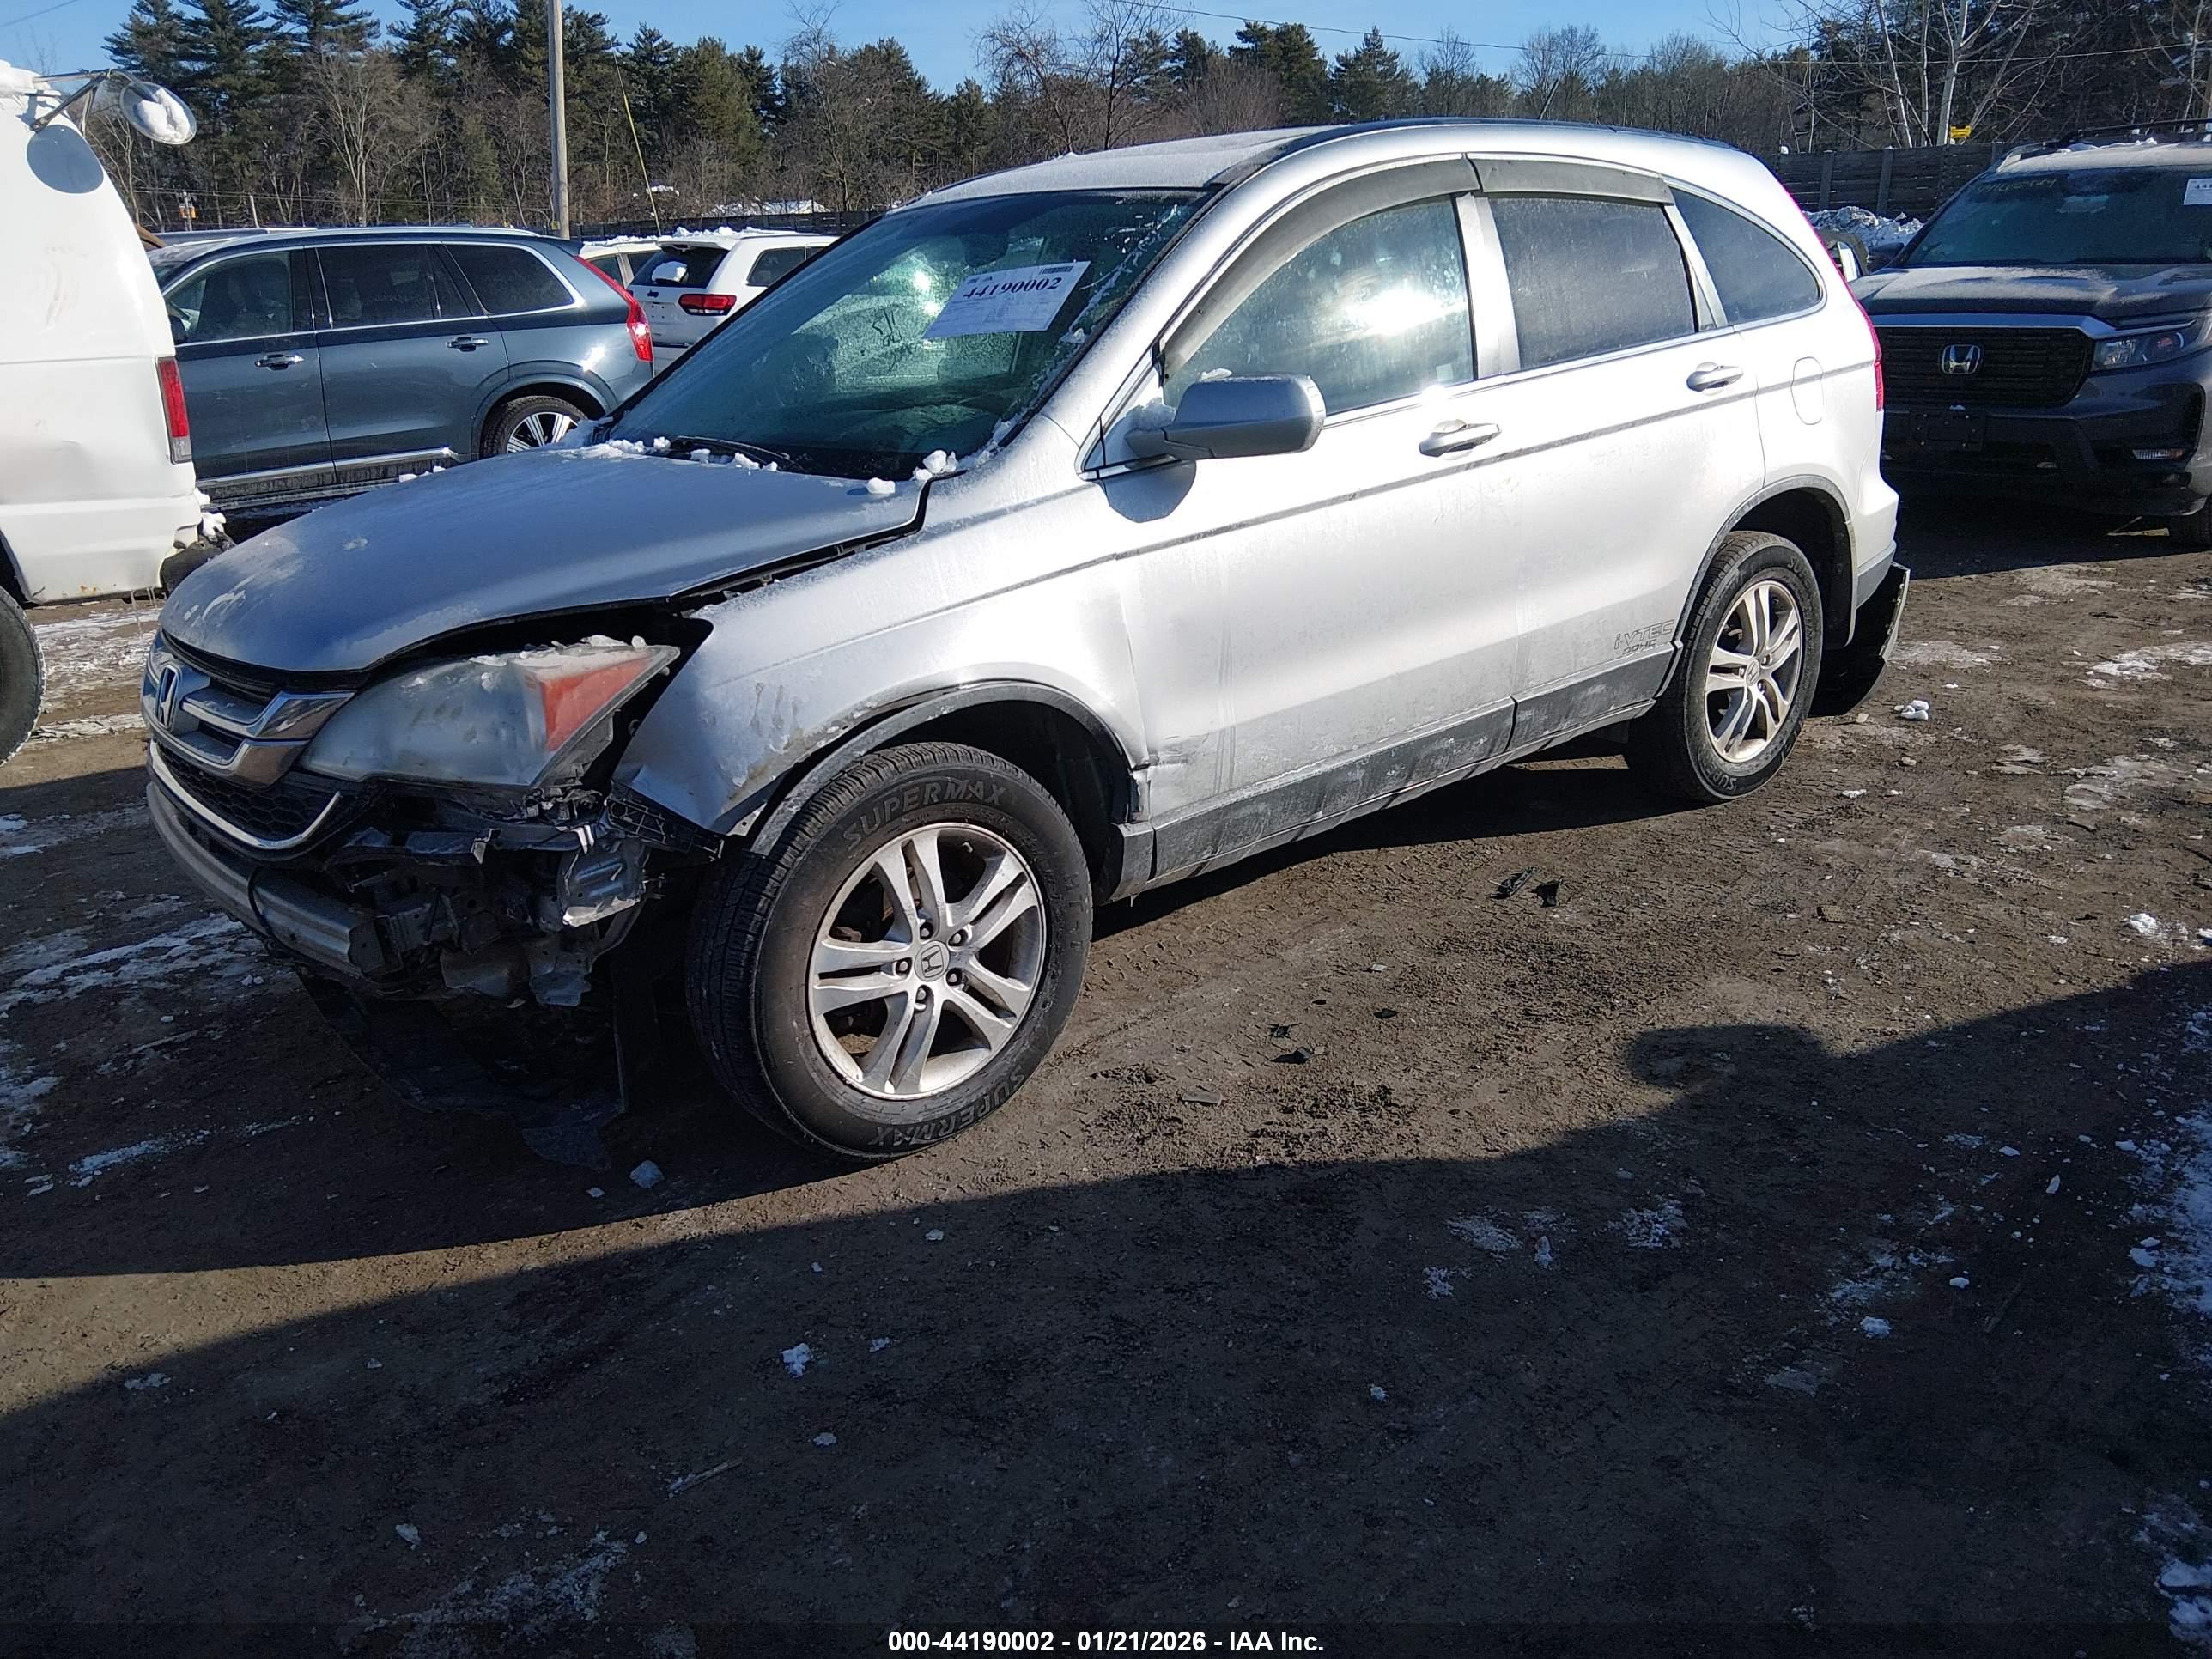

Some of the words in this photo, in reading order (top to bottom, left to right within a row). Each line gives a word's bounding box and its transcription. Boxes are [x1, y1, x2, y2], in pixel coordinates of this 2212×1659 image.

[963, 276, 1062, 299] 44190002
[842, 775, 1007, 851] SUPERMAX
[867, 1066, 1024, 1147] SUPERMAX
